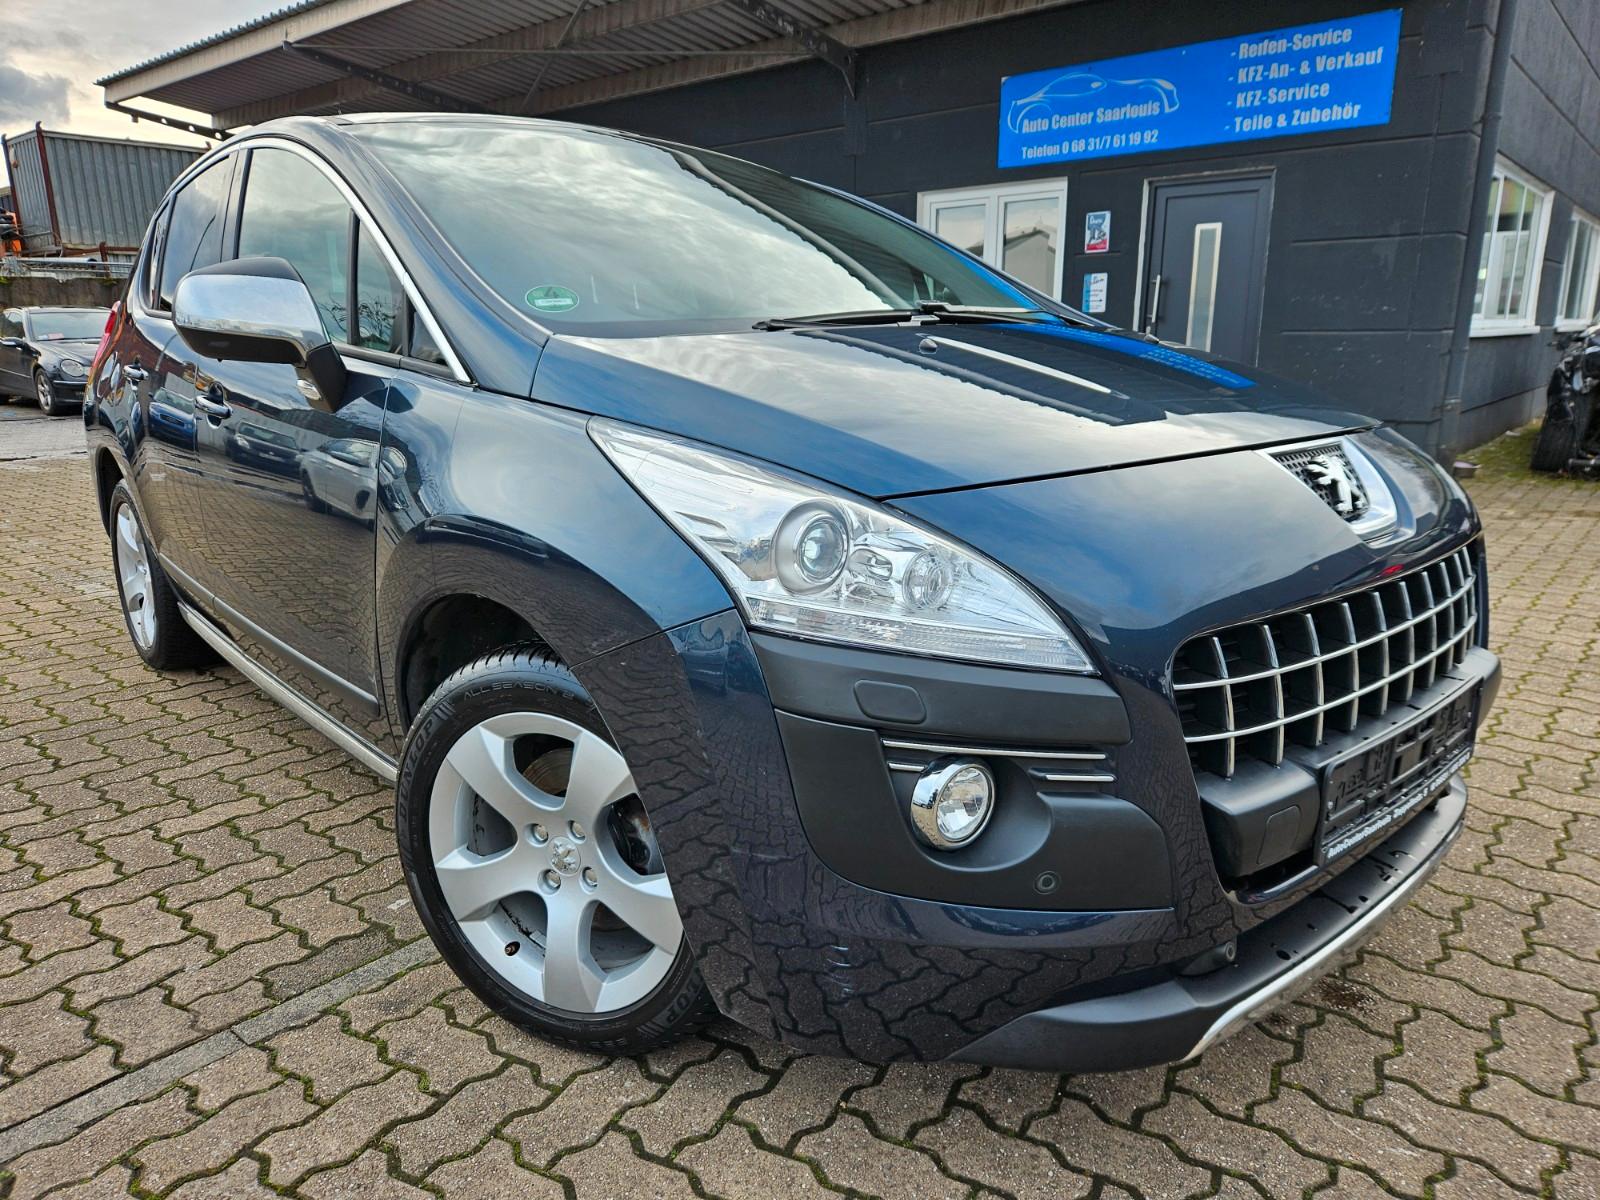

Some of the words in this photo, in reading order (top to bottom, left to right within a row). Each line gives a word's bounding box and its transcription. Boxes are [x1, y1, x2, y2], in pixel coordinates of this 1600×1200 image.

[1239, 28, 1352, 59] Reifen-Service
[1237, 63, 1295, 83] KFZ-An-
[1300, 60, 1310, 75] &
[1315, 46, 1384, 72] Verkauf
[1236, 82, 1330, 108] KFZ-Service
[1022, 118, 1049, 133] Auto
[1051, 111, 1094, 129] Center
[1096, 100, 1160, 123] Saarlouis
[1234, 113, 1272, 133] Teile
[1277, 113, 1287, 127] &
[1291, 102, 1361, 126] Zubehör
[1021, 144, 1059, 159] Telefon
[1062, 141, 1069, 154] 0
[1071, 138, 1085, 153] 68
[1088, 135, 1110, 151] 31/7
[401, 717, 434, 823] DUNLOP
